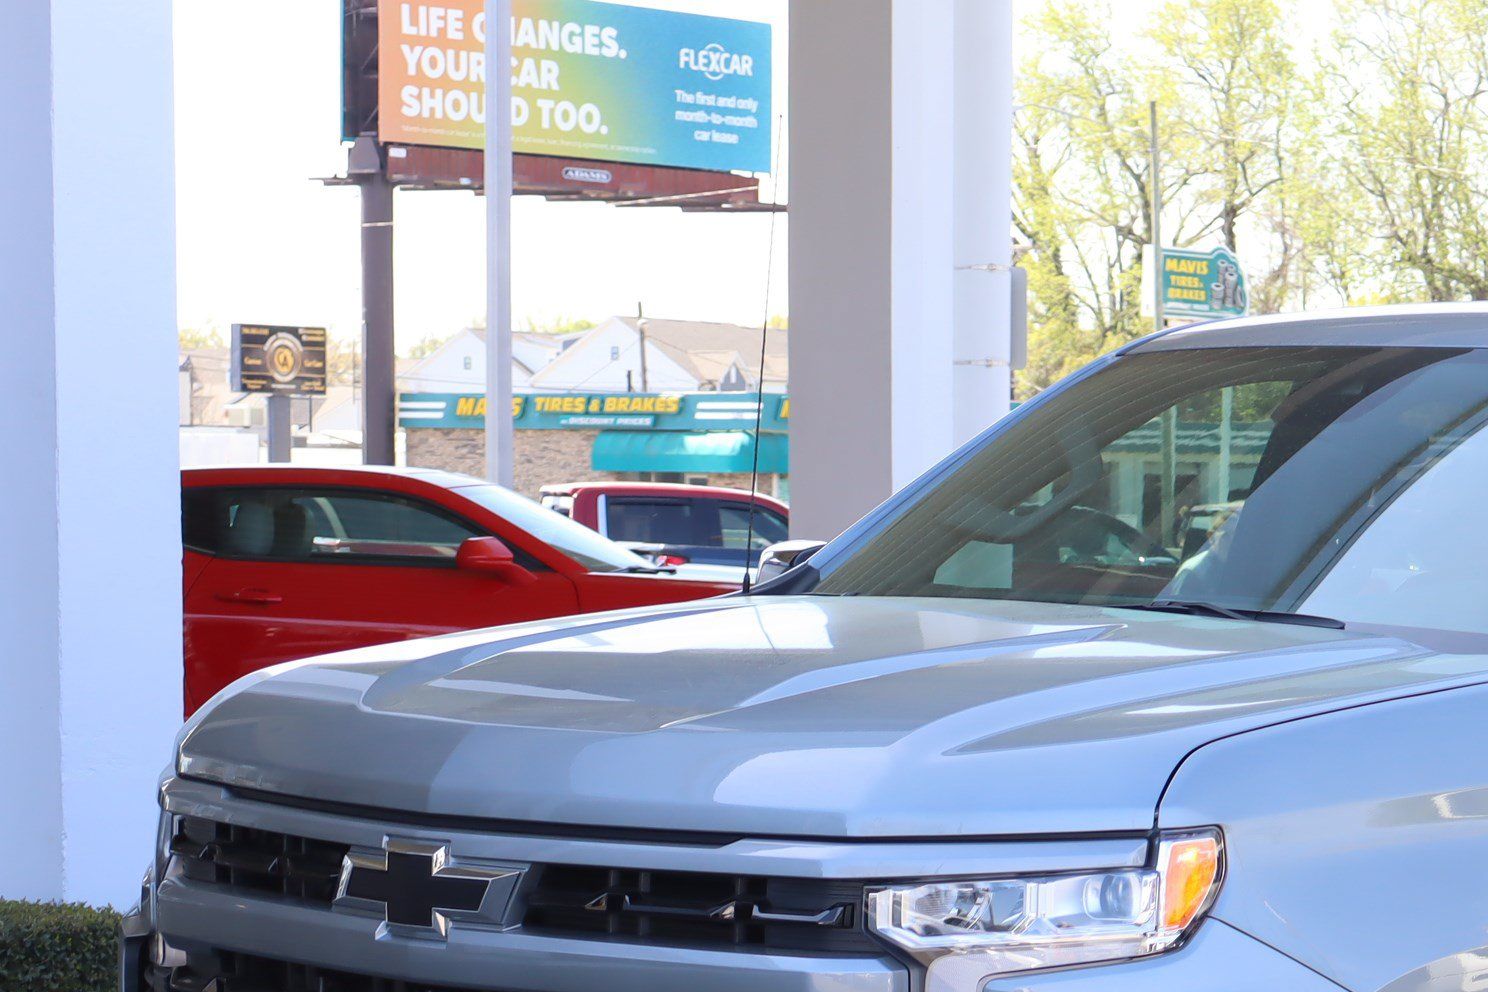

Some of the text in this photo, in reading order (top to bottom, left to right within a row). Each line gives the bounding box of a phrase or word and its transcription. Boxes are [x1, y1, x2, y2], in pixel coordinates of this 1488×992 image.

[401, 3, 627, 59] LIFE CANGES.
[400, 44, 486, 83] YOUR
[679, 47, 754, 77] FLEXCAR
[401, 85, 609, 135] SHOUD TOO.
[675, 90, 695, 104] The
[717, 95, 736, 109] and
[1165, 258, 1208, 274] MAVIS
[1170, 275, 1199, 288] TIRES
[1168, 287, 1206, 301] BRAKES
[456, 396, 681, 417] MAS TIRES & BRAKES
